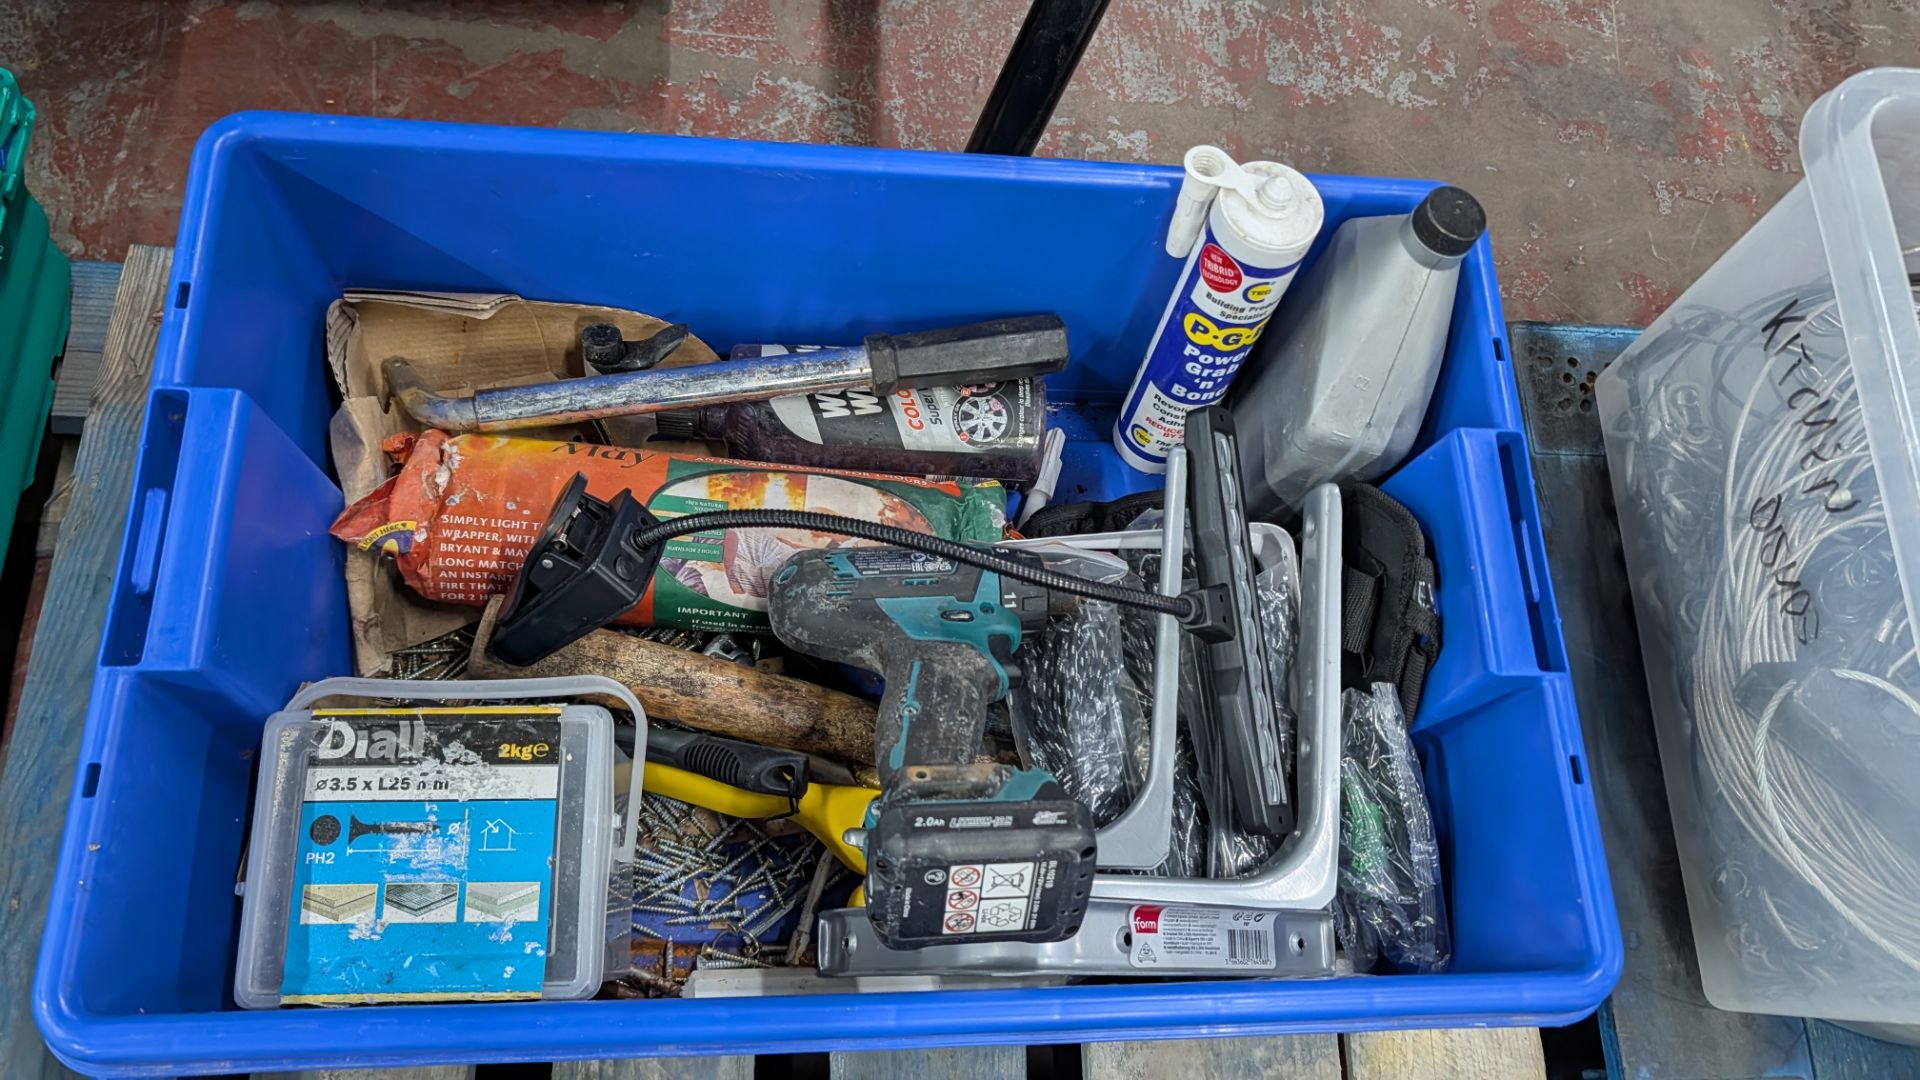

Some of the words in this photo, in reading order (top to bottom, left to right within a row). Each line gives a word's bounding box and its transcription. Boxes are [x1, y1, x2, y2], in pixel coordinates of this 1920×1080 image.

[1204, 258, 1235, 277] TRIBRID
[1206, 291, 1246, 313] Building
[1248, 299, 1279, 312] Produ
[1185, 362, 1240, 378] Grab
[895, 388, 925, 431] COLO
[922, 394, 943, 425] Super
[1152, 403, 1186, 420] Const
[1145, 416, 1185, 434] REDUCE
[441, 514, 489, 526] SIMPLY
[491, 518, 528, 529] LIGHT
[442, 529, 502, 542] WRAPPER,
[440, 544, 489, 555] BRYANT
[492, 547, 501, 555] &
[439, 557, 474, 567] LONG
[478, 559, 524, 570] MATCH
[461, 571, 514, 581] INSTANT
[677, 606, 748, 619] IMPORTANT
[318, 717, 425, 759] Diall
[363, 780, 373, 791] x
[378, 776, 411, 791] L25
[914, 816, 946, 828] 2.0Ah
[305, 852, 335, 865] PH2
[1133, 916, 1157, 930] form
